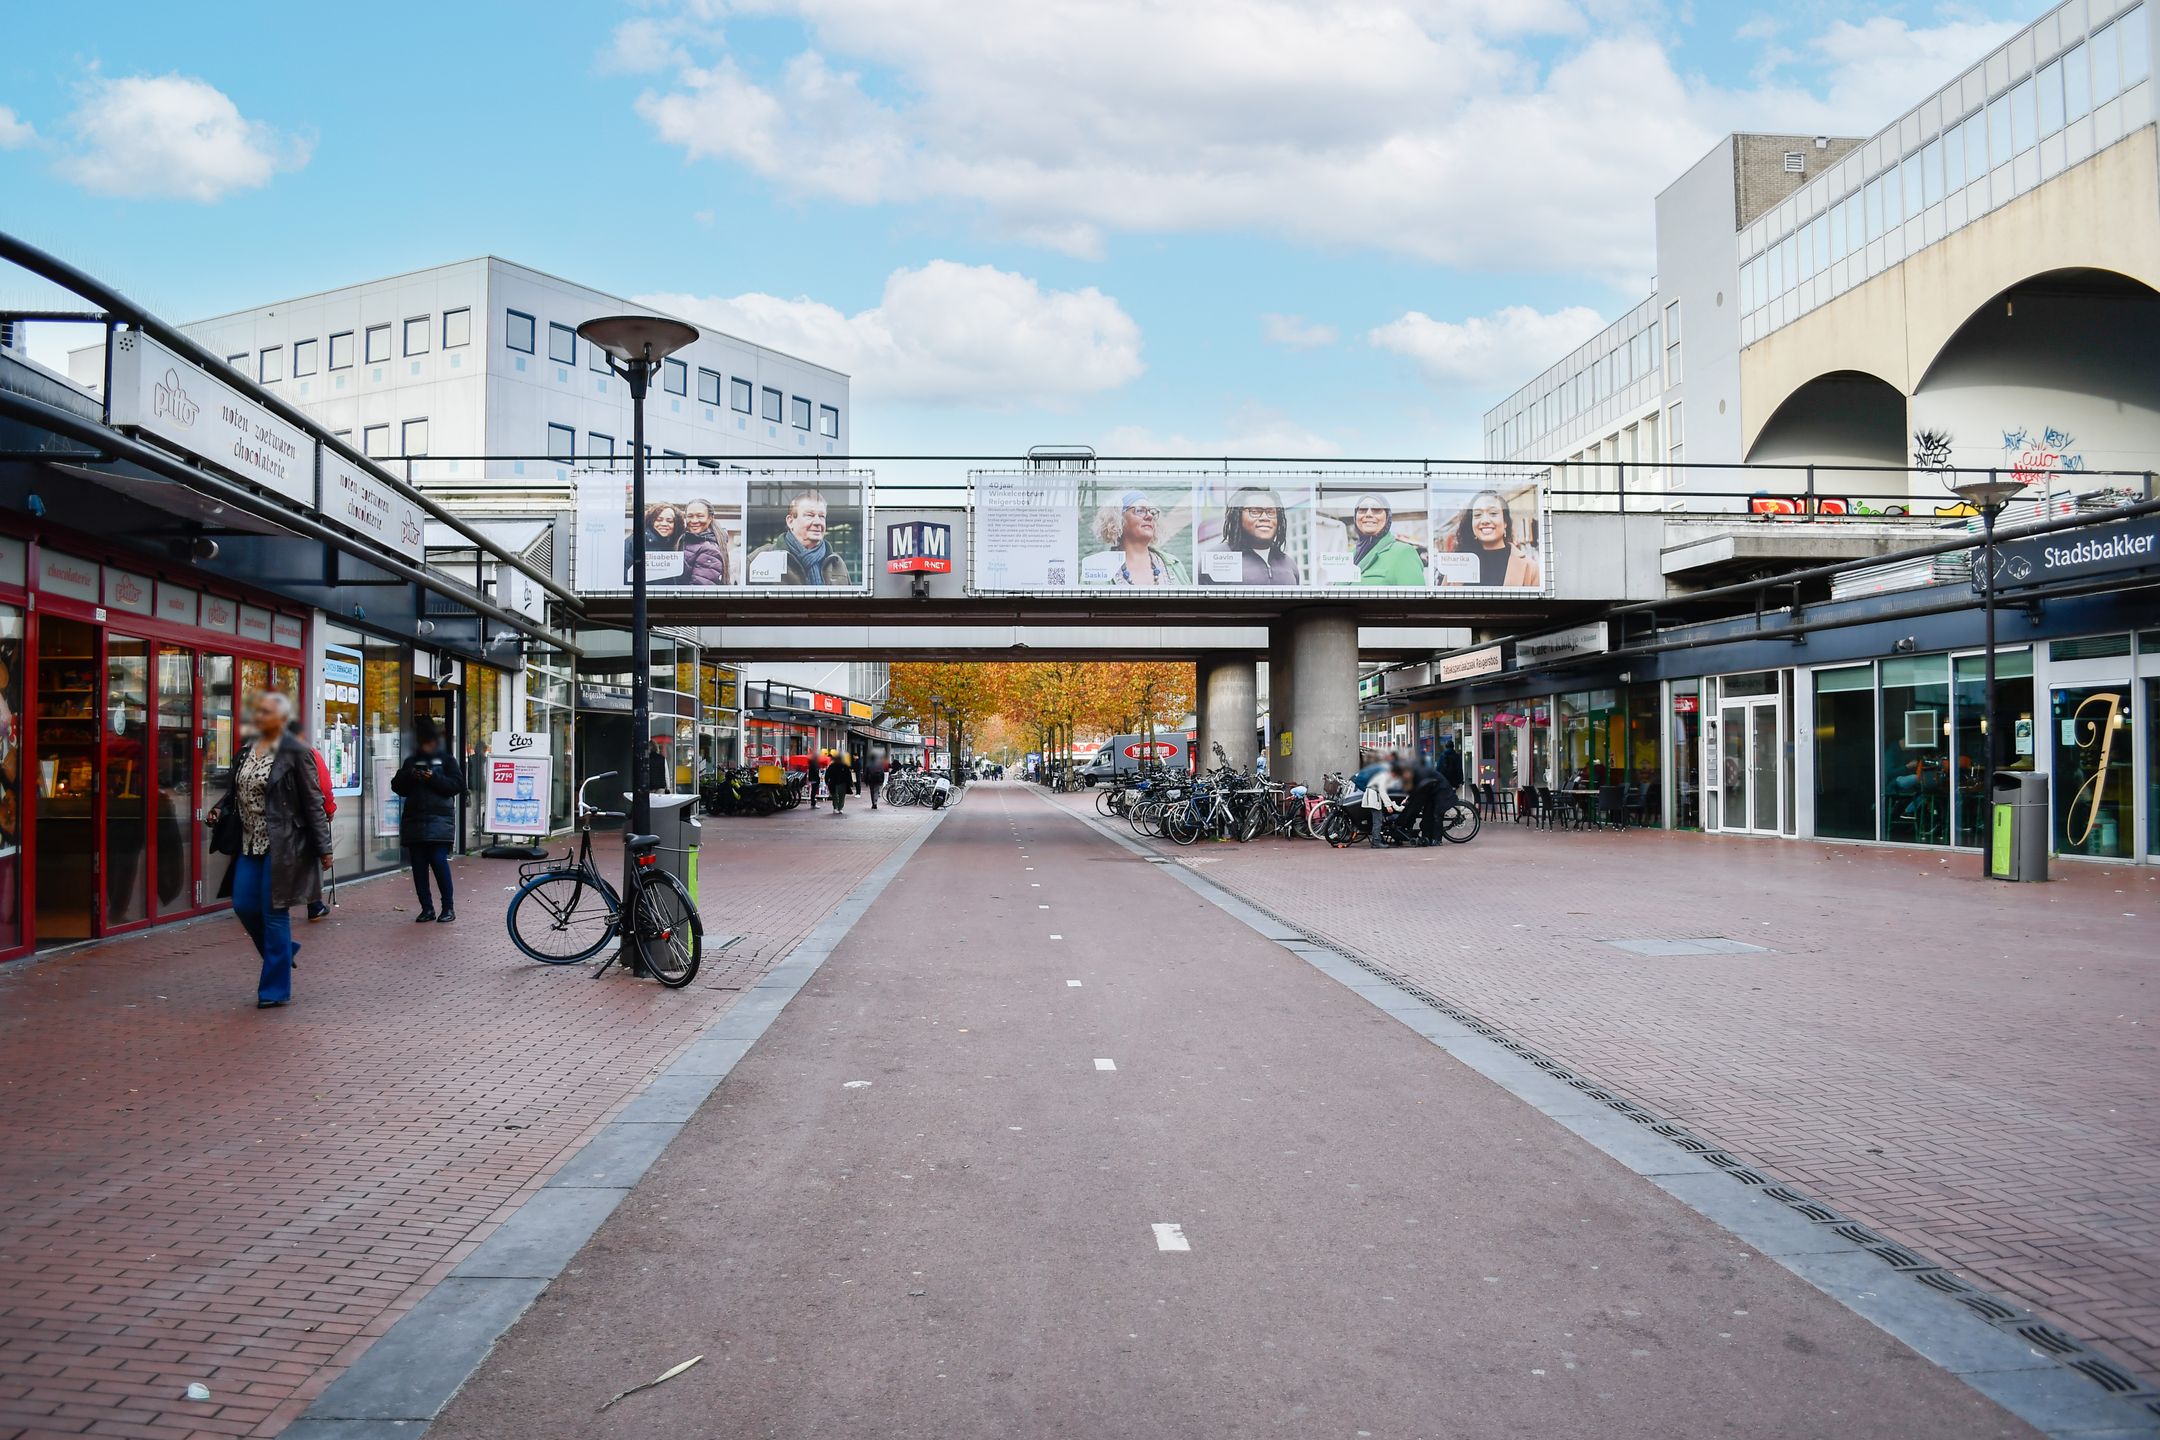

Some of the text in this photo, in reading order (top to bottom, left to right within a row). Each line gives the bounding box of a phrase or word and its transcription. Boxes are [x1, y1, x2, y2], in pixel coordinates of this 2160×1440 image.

[222, 405, 296, 460] noten zoetwaren
[233, 437, 285, 479] chocolaterie
[340, 473, 390, 514] noten zoetwaren
[999, 481, 1014, 490] jaar
[347, 498, 382, 530] chocolaterie
[988, 499, 1030, 507] Reigersbos
[893, 526, 912, 556] M
[924, 526, 945, 556] M
[2044, 534, 2155, 568] Stadsbakker
[1322, 555, 1350, 563] Suraiya
[48, 563, 93, 587] chocolaterie
[1084, 571, 1108, 579] Saskia
[1476, 656, 1499, 670] Reigersbos
[509, 733, 533, 747] Etos
